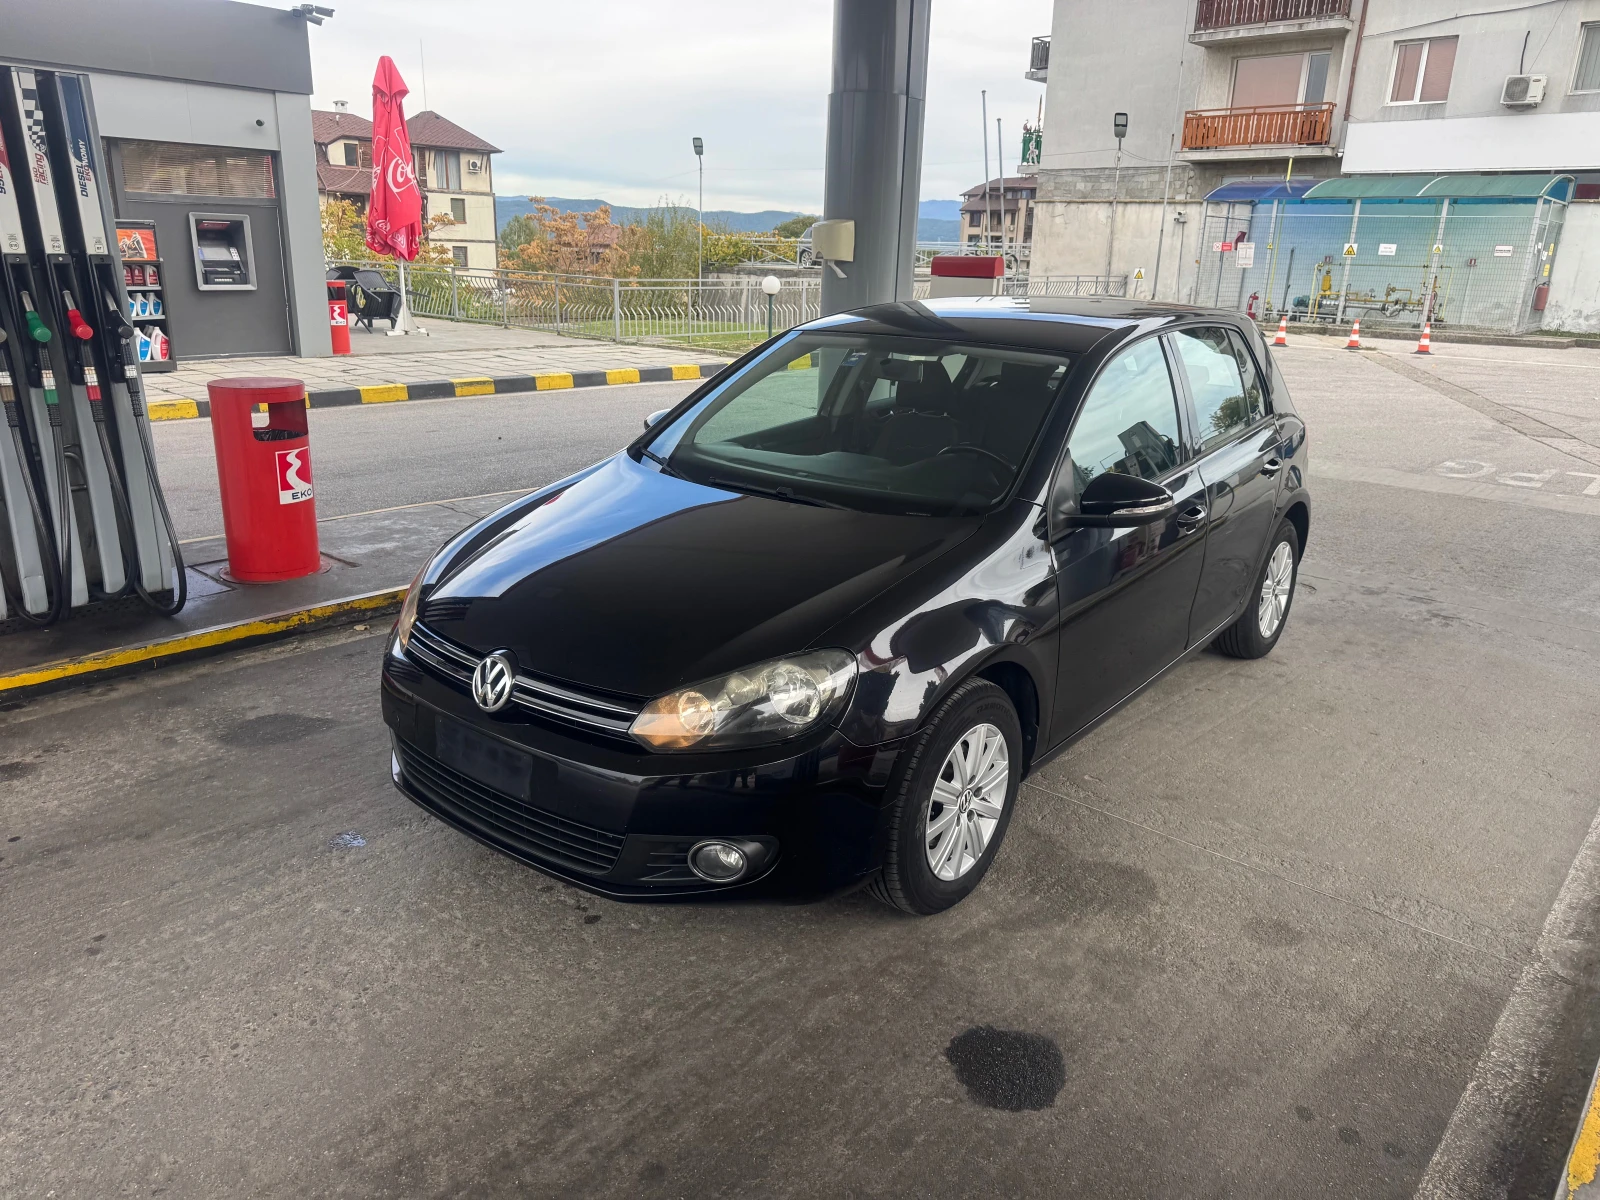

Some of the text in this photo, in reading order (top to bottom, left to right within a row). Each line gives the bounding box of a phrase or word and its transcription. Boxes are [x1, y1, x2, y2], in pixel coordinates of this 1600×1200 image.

[34, 153, 47, 185] racing
[76, 163, 89, 197] DIESEL
[291, 488, 313, 500] EKO
